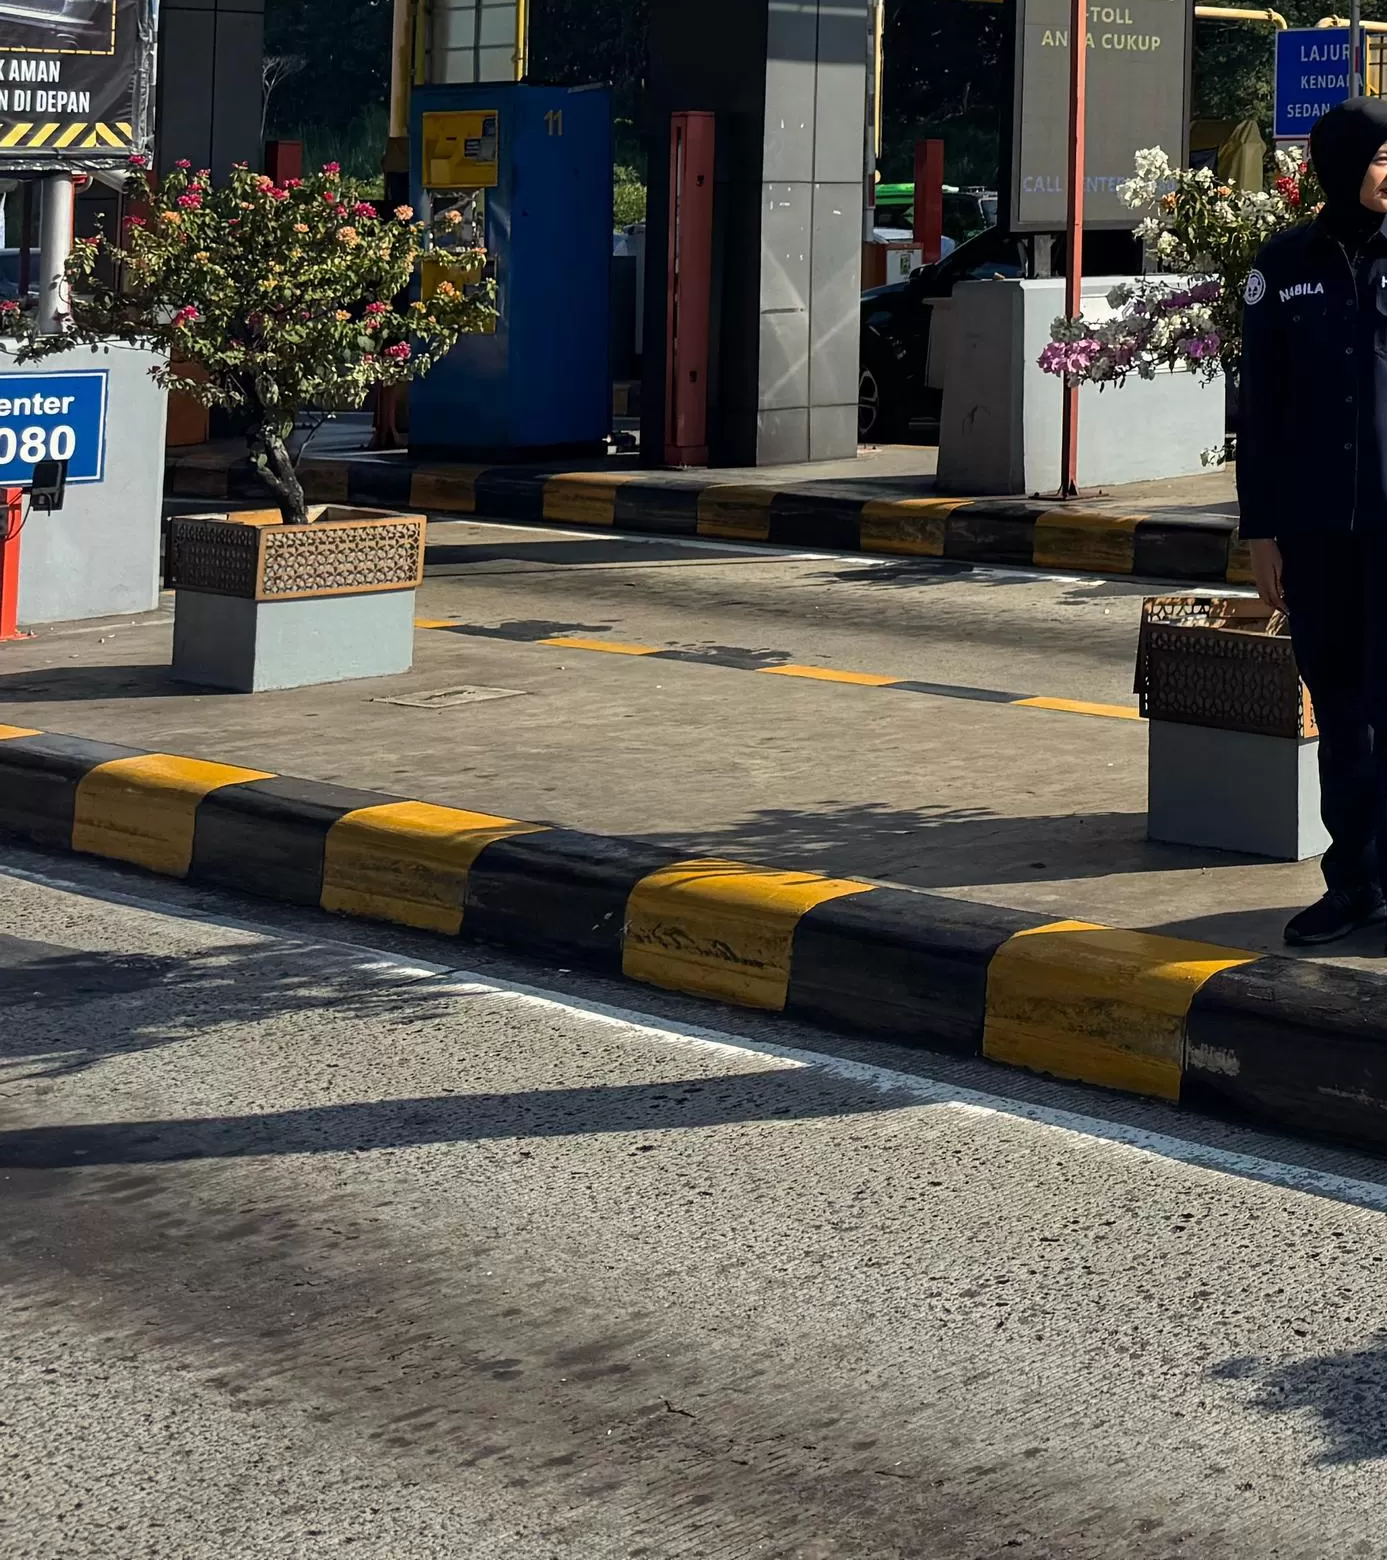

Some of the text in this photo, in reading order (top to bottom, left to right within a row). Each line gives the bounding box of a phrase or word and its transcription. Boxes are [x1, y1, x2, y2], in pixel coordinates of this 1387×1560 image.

[1041, 30, 1161, 51] ANA CUKUP
[9, 59, 60, 82] AMAN
[14, 90, 31, 112] DI
[36, 90, 90, 113] DEPAN
